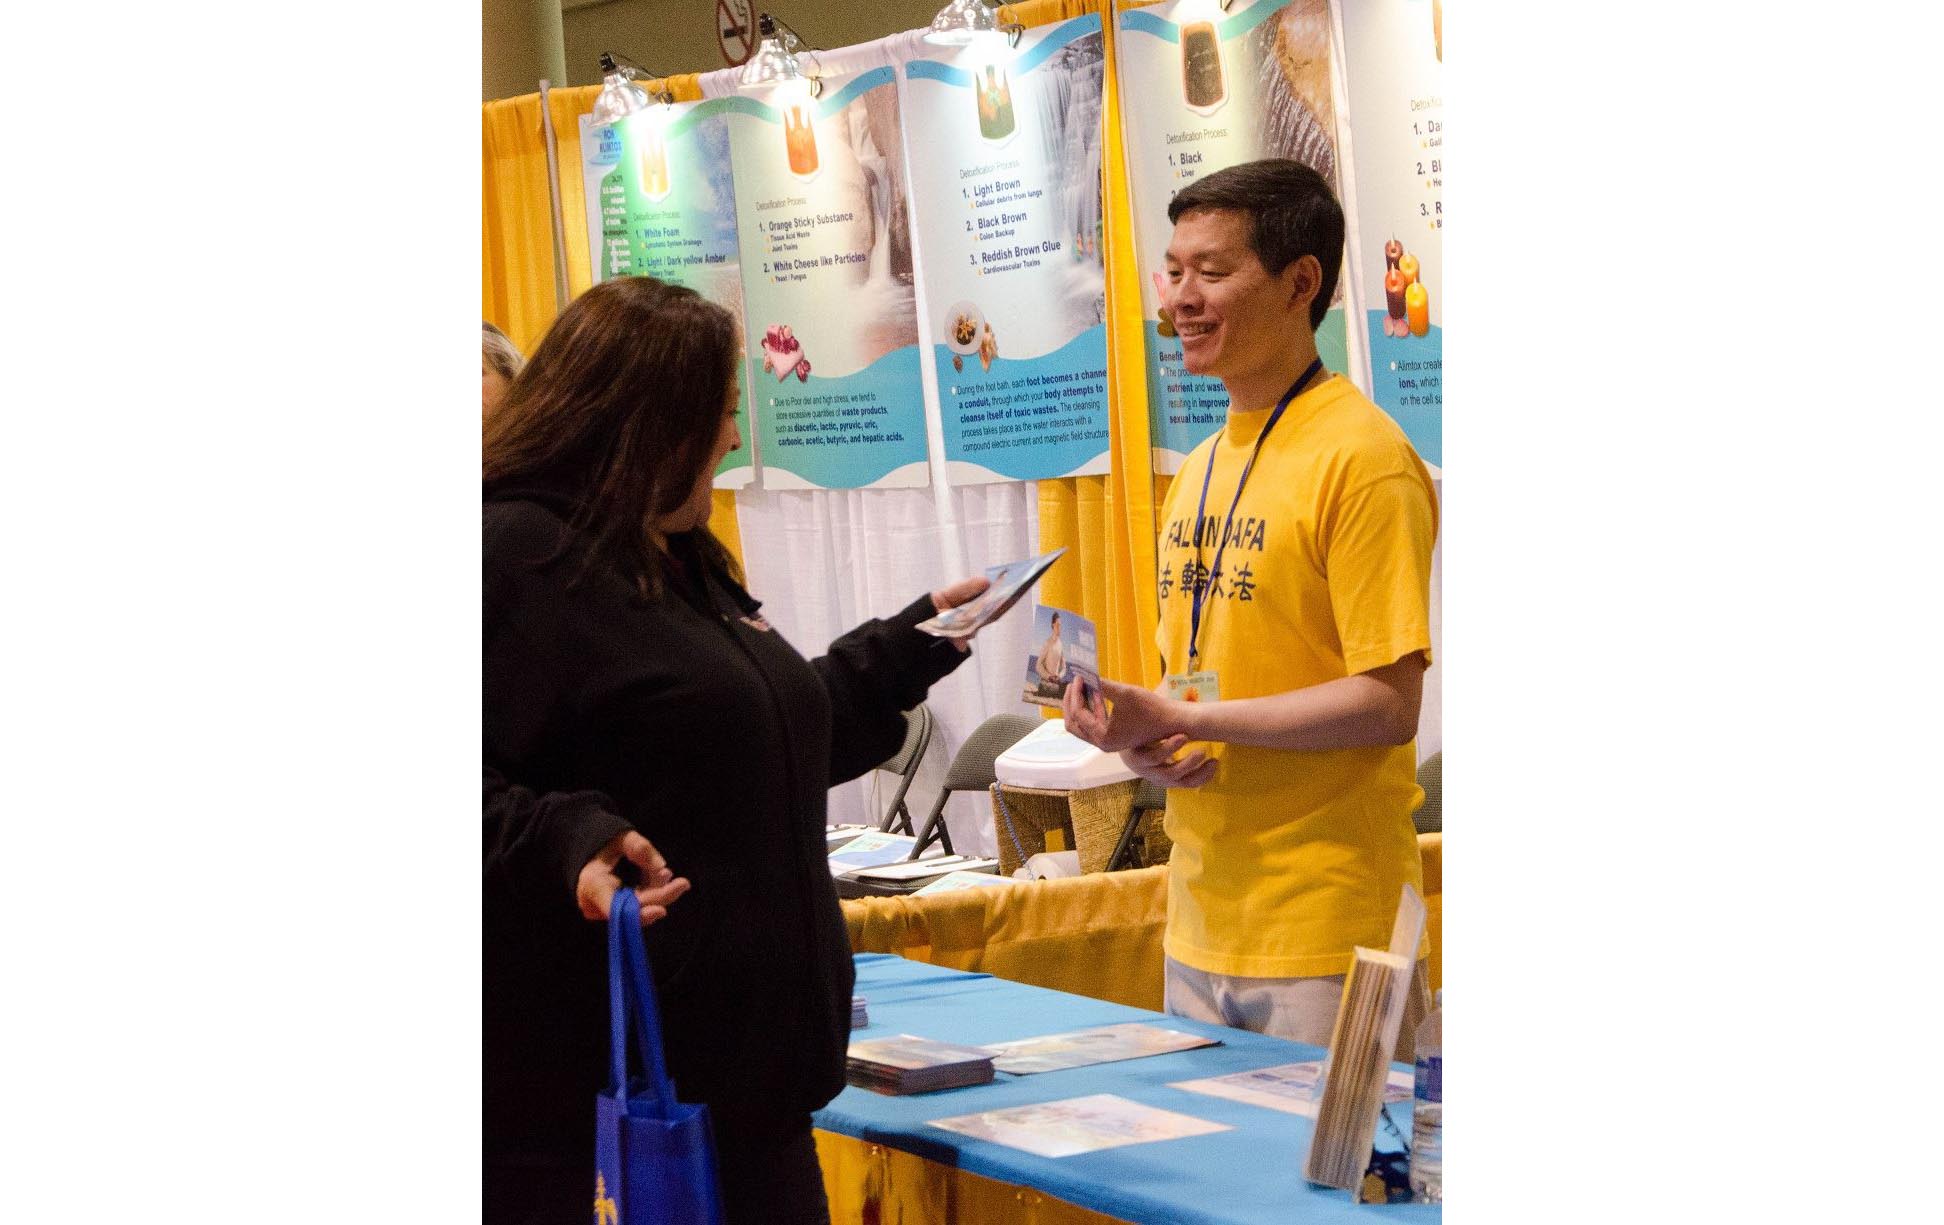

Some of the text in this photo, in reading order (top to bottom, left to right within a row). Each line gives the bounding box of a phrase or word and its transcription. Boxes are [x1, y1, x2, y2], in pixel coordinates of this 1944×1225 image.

[1414, 122, 1422, 135] 1.
[1166, 131, 1202, 144] Detoxification
[1169, 151, 1202, 166] 1. Black
[960, 166, 995, 179] Detoxification
[1182, 169, 1194, 177] Liver
[1417, 162, 1425, 175] 2.
[963, 179, 1020, 198] 1. Light Brown
[976, 199, 995, 208] Cellular
[997, 195, 1012, 203] debris
[1028, 189, 1042, 198] lungs
[1421, 203, 1429, 216] 3.
[759, 212, 853, 232] 1. Orange Sticky Substance
[966, 211, 1027, 231] 2. Black Brown
[644, 228, 662, 238] White
[664, 228, 680, 237] Foam
[980, 228, 1014, 241] Colon Backup
[970, 240, 1061, 265] 3. Reddish Brown Glue
[639, 258, 644, 267] 2.
[647, 256, 662, 268] Light
[668, 256, 682, 266] Dark
[684, 255, 703, 269] yellow
[705, 253, 726, 263] Amber
[764, 253, 865, 273] 2. White Cheese like Particles
[983, 259, 1040, 275] Cardiovascular Toxins
[791, 273, 807, 282] Fungus
[1160, 352, 1183, 361] Benefit
[1423, 358, 1442, 370] create
[986, 382, 996, 391] foot
[1012, 380, 1025, 388] each
[1027, 377, 1040, 386] foot
[1042, 374, 1073, 384] becomes
[1081, 369, 1107, 379] channe
[1399, 376, 1439, 389] ions, which
[1168, 383, 1193, 393] nutrient
[1195, 383, 1205, 392] and
[965, 398, 991, 408] conduit,
[992, 395, 1012, 405] through
[1014, 393, 1030, 402] which
[1031, 393, 1043, 403] your
[1045, 388, 1060, 400] body
[1063, 385, 1094, 397] attempts
[1096, 384, 1103, 393] to
[1192, 399, 1198, 407] in
[1199, 397, 1230, 409] improved
[1401, 397, 1408, 406] on
[1410, 394, 1420, 405] the
[1422, 392, 1433, 404] cell
[789, 411, 811, 419] excessive
[842, 408, 860, 417] waste
[961, 400, 1100, 423] cleanse itself of toxic wastes. The cleansing
[840, 420, 863, 433] pyruvic,
[864, 418, 878, 430] uric,
[1170, 415, 1191, 424] sexual
[1192, 414, 1213, 423] health
[962, 416, 1092, 438] process takes place as the water interacts with a
[850, 433, 861, 443] and
[863, 431, 885, 444] hepatic
[886, 430, 904, 442] acids.
[963, 441, 990, 451] compound
[992, 439, 1011, 448] electric
[1012, 437, 1031, 447] current
[1032, 435, 1043, 445] and
[1044, 432, 1070, 445] magnetic
[1071, 430, 1083, 440] field
